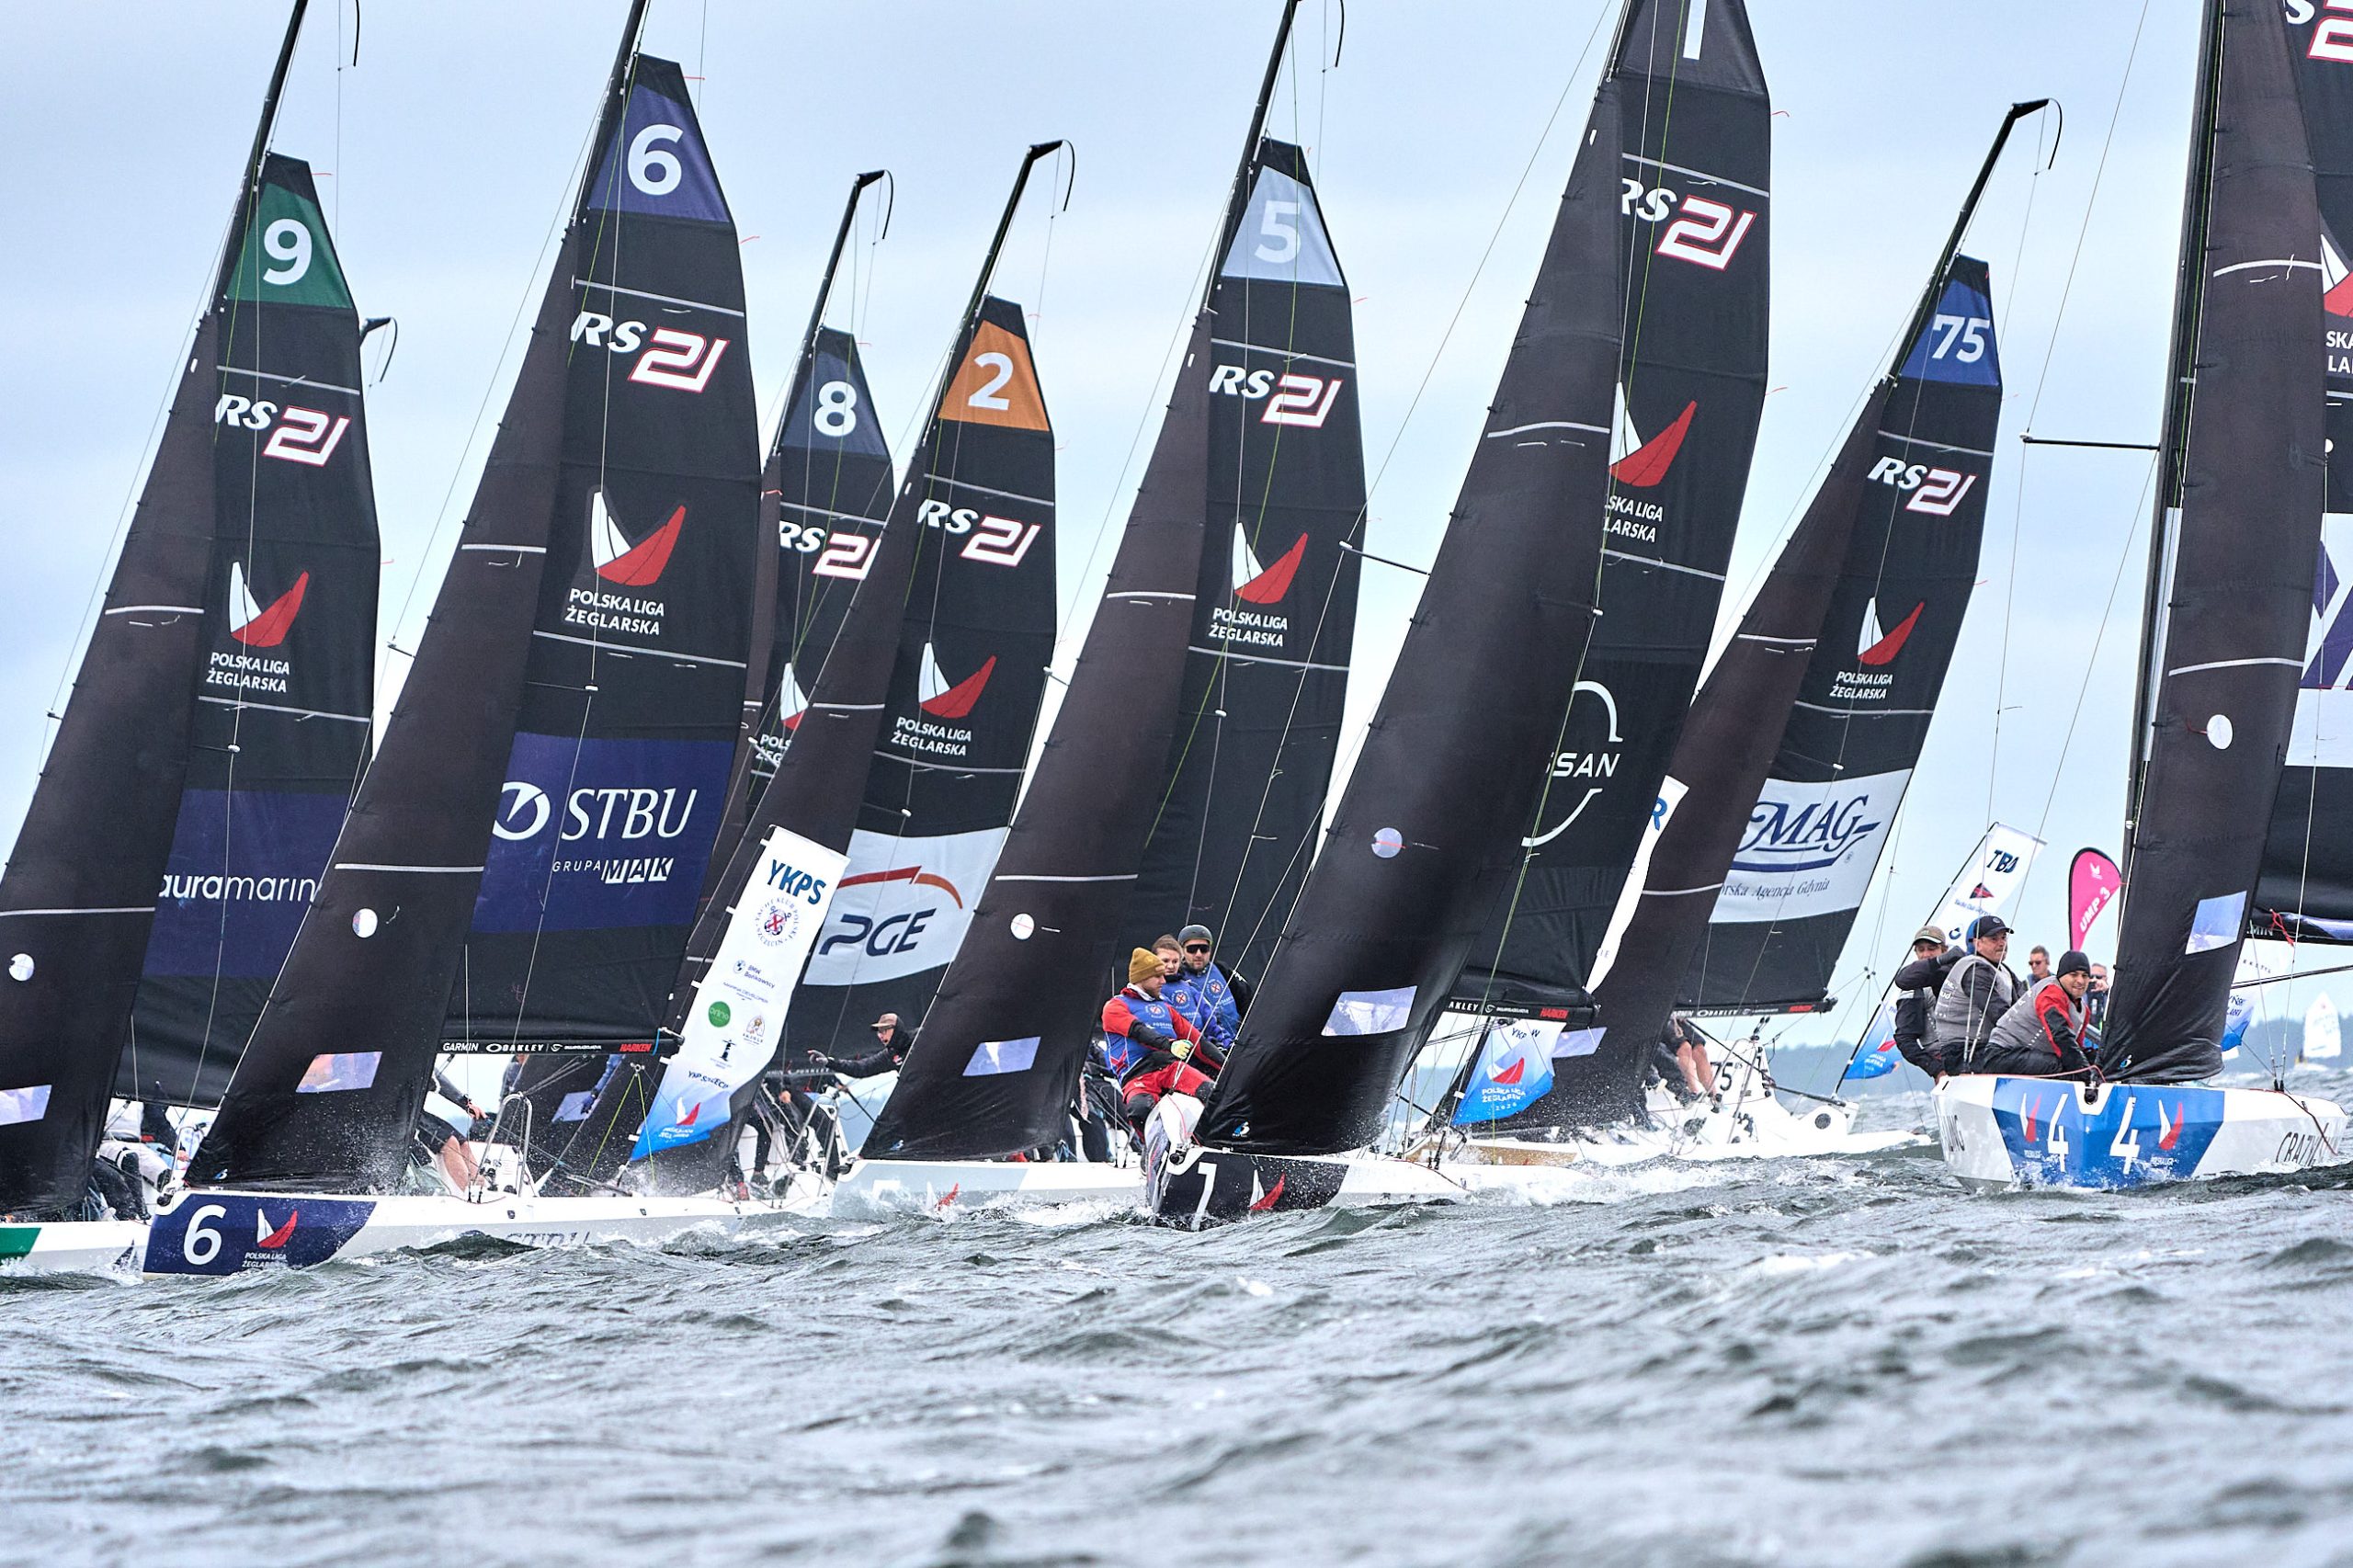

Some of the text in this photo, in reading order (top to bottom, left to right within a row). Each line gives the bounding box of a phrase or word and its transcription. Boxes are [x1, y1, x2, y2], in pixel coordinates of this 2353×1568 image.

[628, 122, 684, 196] 6
[1255, 199, 1301, 264] 5
[263, 218, 313, 285] 9
[1932, 314, 1990, 362] 75
[968, 352, 1013, 411] 2
[814, 381, 857, 437] 8
[1634, 501, 1664, 522] LIGA
[569, 588, 665, 617] POLSKA LIGA
[564, 605, 660, 635] ŻEGLARSKA
[1212, 608, 1288, 630] POLSKA LIGA
[1208, 622, 1283, 647] ŻEGLARSKA
[210, 652, 290, 675] POLSKA LIGA
[1836, 671, 1893, 685] POLSKA LIGA
[206, 667, 287, 692] ŻEGLARSKA
[1829, 683, 1887, 699] ŻEGLARSKA
[891, 729, 966, 756] ŻEGLARSKA
[896, 716, 972, 742] POLSKA LIGA
[561, 788, 698, 841] STBU
[552, 858, 675, 884] GRUPA MAK
[767, 858, 827, 905] YKPS
[1751, 885, 1793, 901] Agencja
[1797, 878, 1831, 898] Gdynia
[818, 908, 937, 957] PGE
[747, 964, 762, 975] BMW
[442, 1042, 652, 1053] GARMIN OAKLEY HARKEN
[2048, 1094, 2068, 1173] 4
[2109, 1096, 2141, 1175] 4
[1190, 1162, 1217, 1232] 7
[184, 1204, 227, 1266] 6
[244, 1252, 270, 1260] POLSKA
